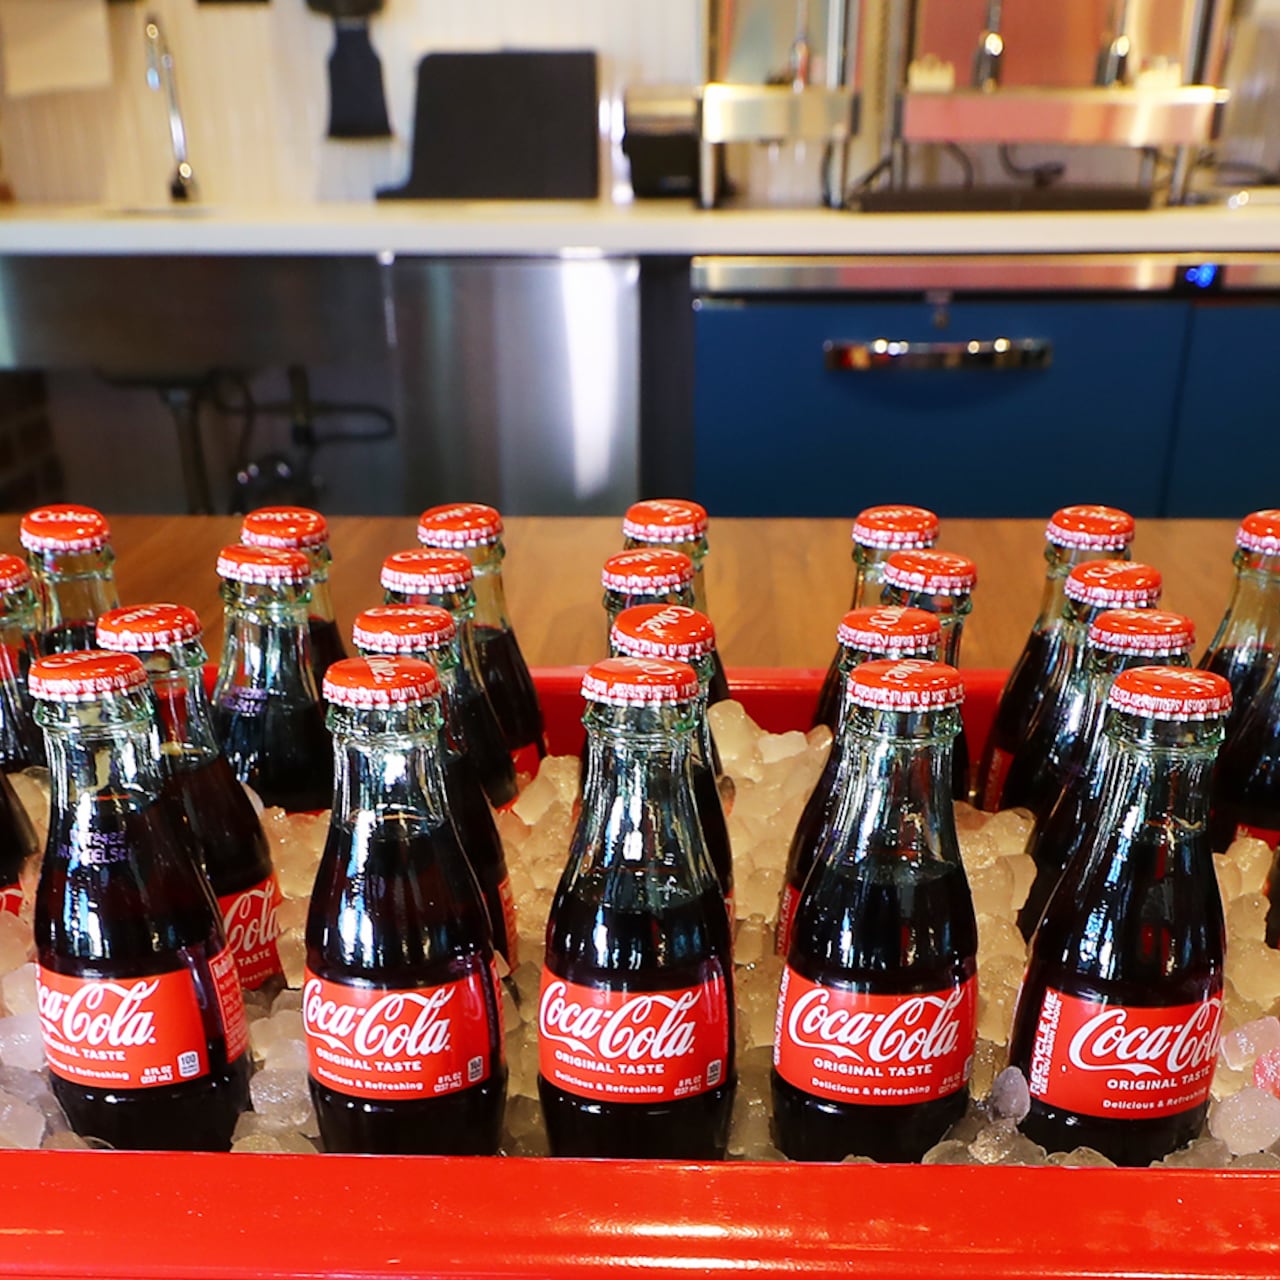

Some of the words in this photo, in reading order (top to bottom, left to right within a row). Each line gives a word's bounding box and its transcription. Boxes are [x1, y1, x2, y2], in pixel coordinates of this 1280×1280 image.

[29, 511, 98, 523] Coke
[303, 978, 455, 1057] Coca-Cola
[540, 981, 702, 1060] Coca-Cola
[788, 988, 964, 1063] Coca-Cola
[81, 1048, 126, 1061] TASTE
[1029, 1020, 1051, 1096] RECYCLE
[1046, 990, 1058, 1018] ME
[316, 1047, 371, 1071] ORIGINAL
[375, 1060, 422, 1072] TASTE
[555, 1050, 614, 1073] ORIGINAL
[618, 1063, 664, 1074] TASTE
[814, 1057, 883, 1077] ORIGINAL
[888, 1064, 932, 1077] TASTE
[365, 1082, 423, 1091] Refreshing
[555, 1070, 593, 1089] Delicious
[595, 1081, 604, 1091] &
[606, 1084, 664, 1094] Refreshing
[812, 1077, 859, 1094] Delicious
[862, 1086, 870, 1095] &
[873, 1085, 930, 1096] Refreshing
[1106, 1078, 1178, 1091] ORIGINAL
[1182, 1065, 1211, 1084] TASTE
[1102, 1099, 1154, 1110] Delicious
